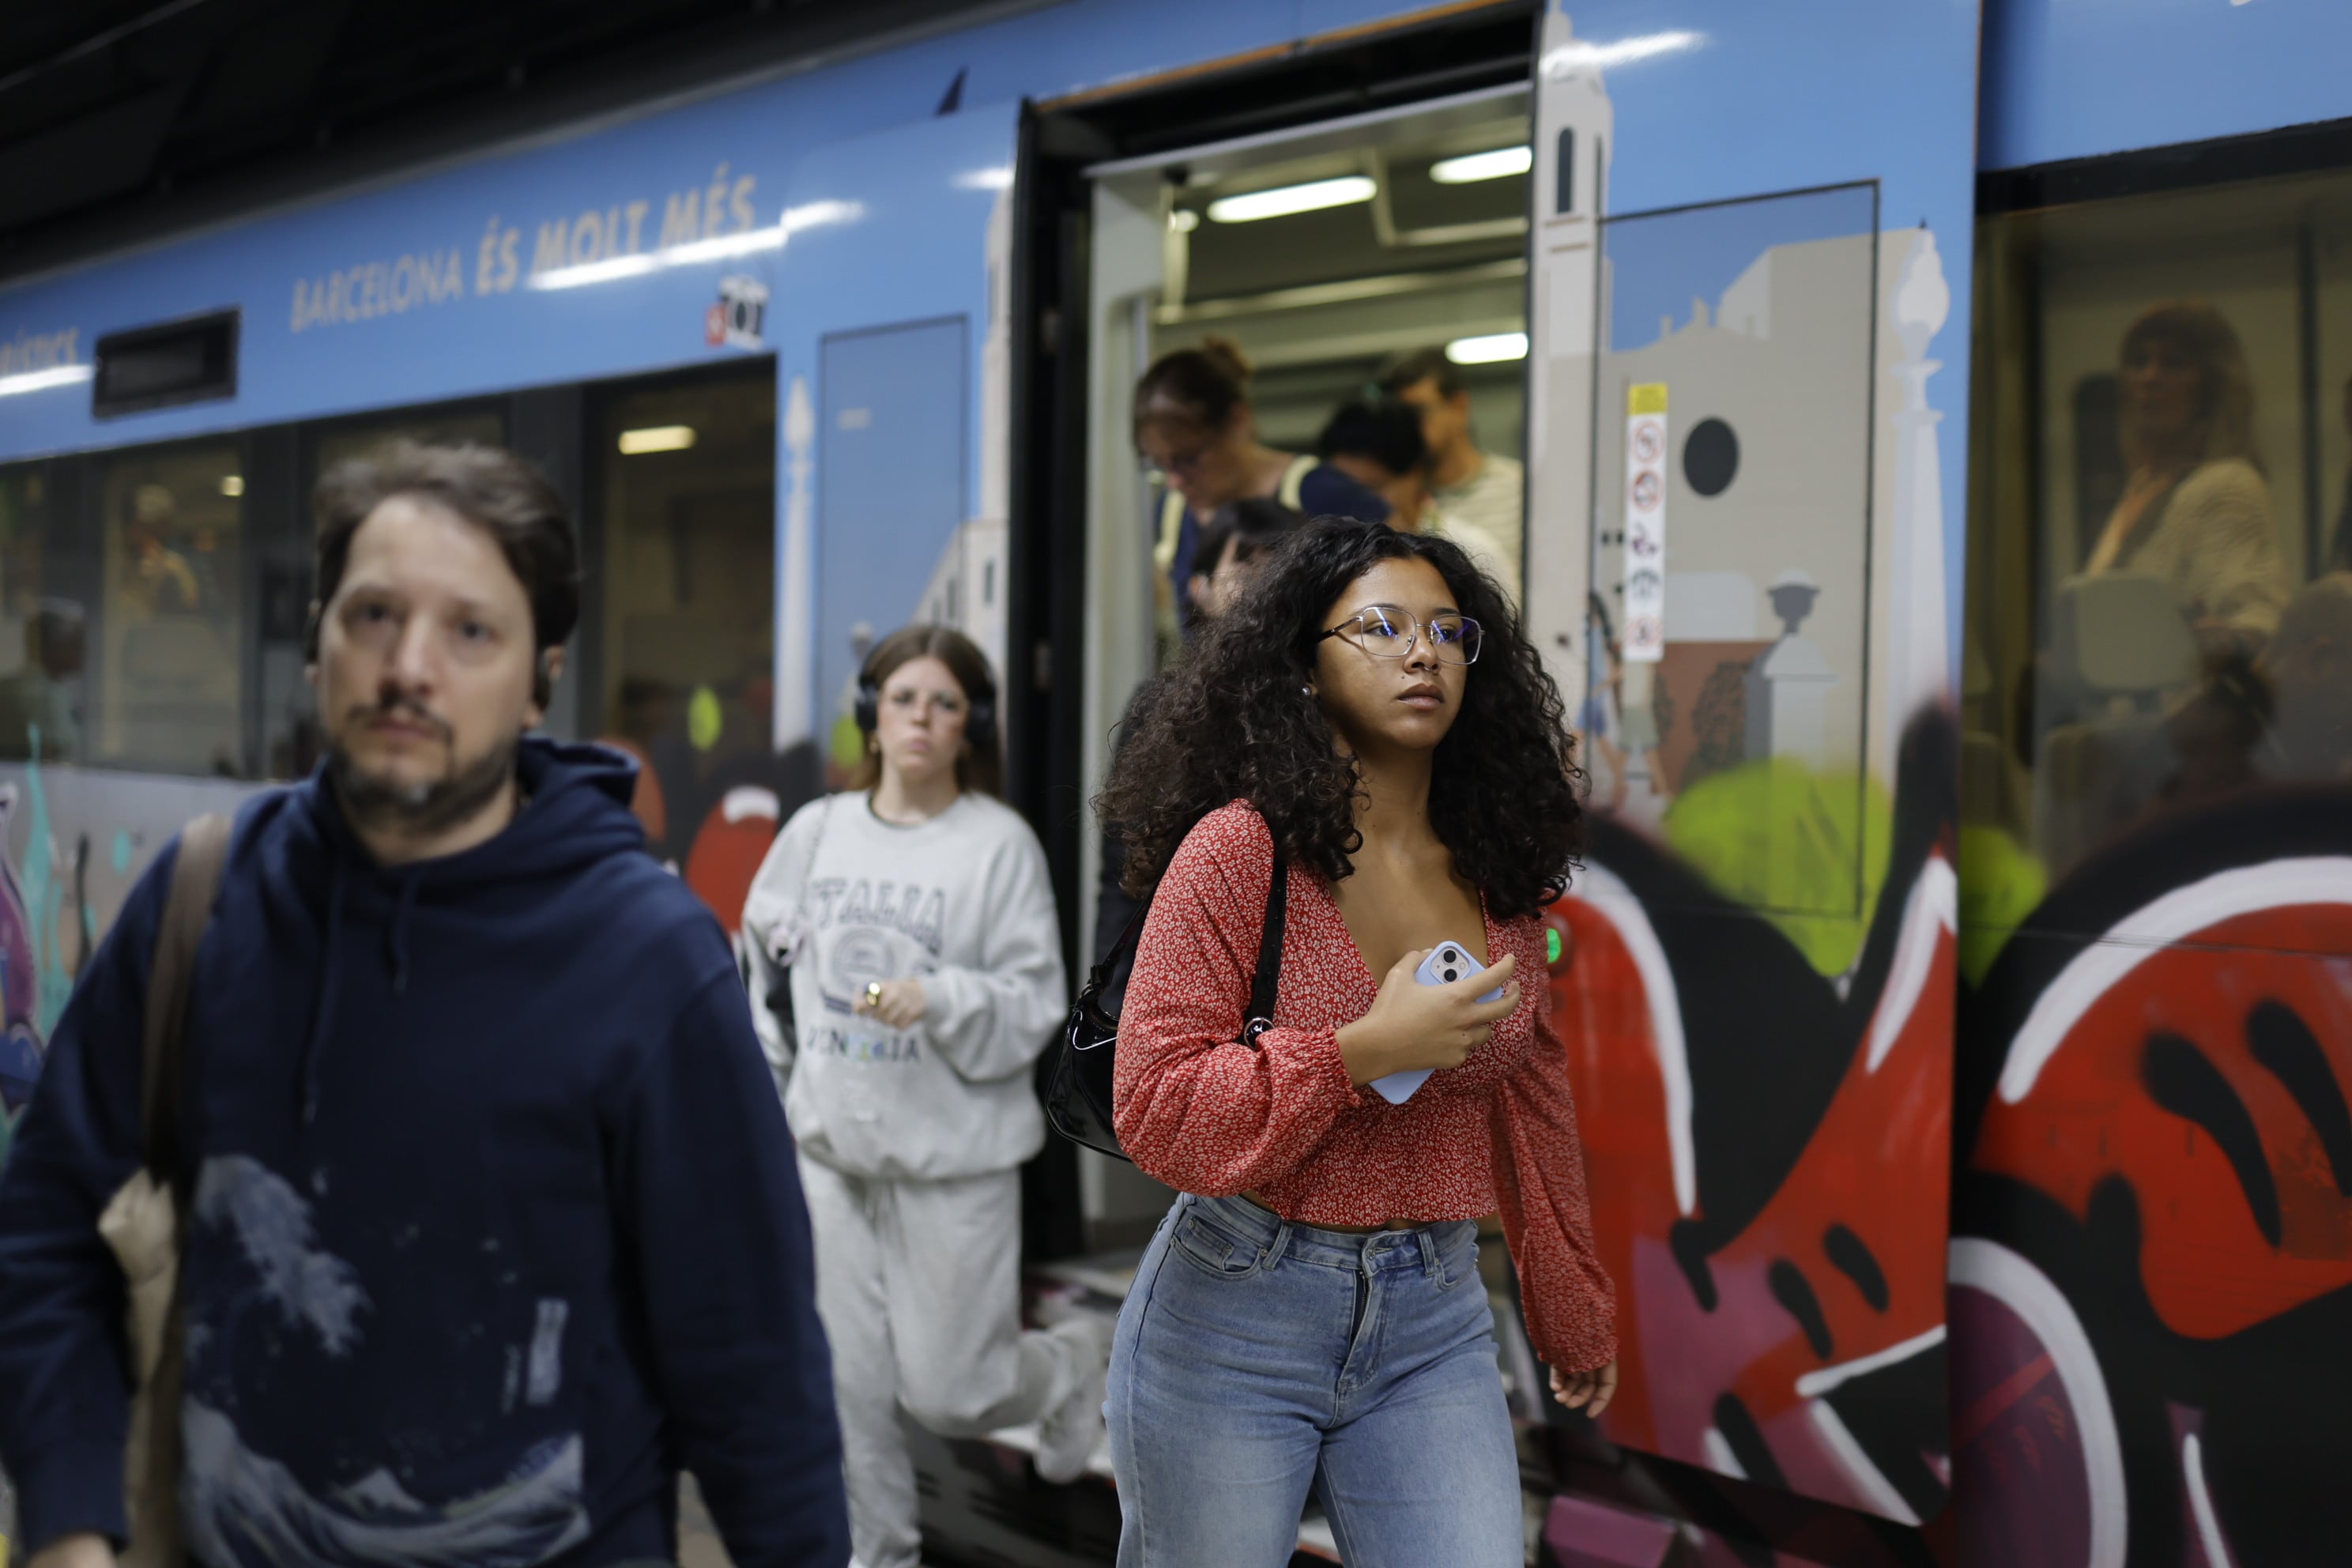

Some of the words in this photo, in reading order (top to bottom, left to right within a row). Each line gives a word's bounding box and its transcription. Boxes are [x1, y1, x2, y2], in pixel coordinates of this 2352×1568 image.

[290, 247, 463, 333] BARCELONA
[475, 213, 521, 296] ÉS
[530, 199, 649, 277] MOLT
[659, 160, 756, 254] MÉS
